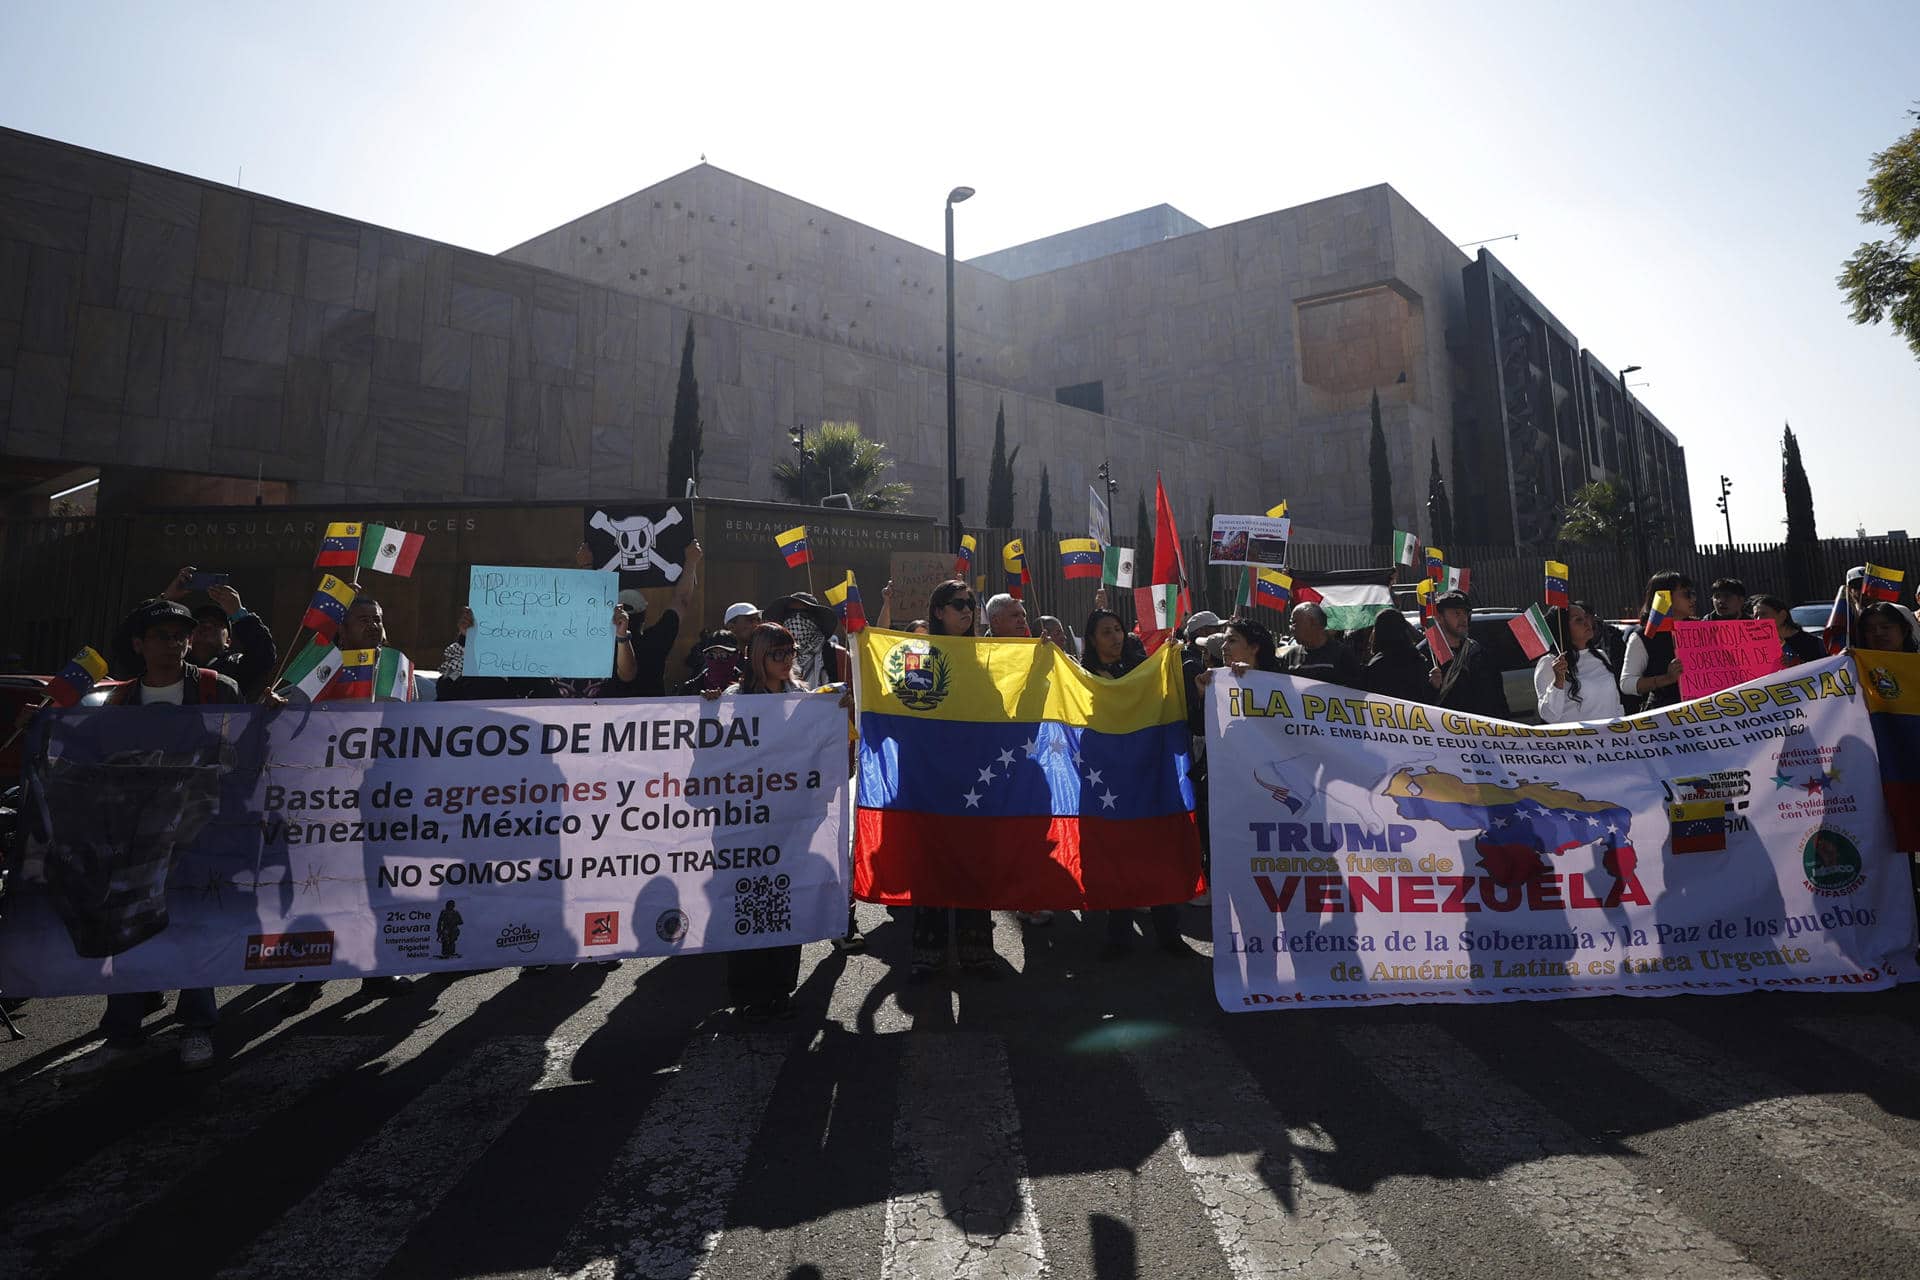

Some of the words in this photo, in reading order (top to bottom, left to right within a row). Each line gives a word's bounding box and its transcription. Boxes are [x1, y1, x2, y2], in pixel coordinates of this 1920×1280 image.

[164, 523, 316, 536] CONSULAR
[875, 530, 920, 542] CENTER
[1754, 646, 1773, 664] DE
[1301, 694, 1433, 733] PATRIA
[1667, 667, 1857, 726] RESPETA!
[324, 723, 531, 768] ¡GRINGOS
[540, 722, 592, 755] DE
[602, 716, 760, 753] MIERDA!
[1284, 723, 1325, 737] CITA:
[1331, 727, 1409, 746] EMBAJADA
[1413, 736, 1434, 747] DE
[1437, 737, 1477, 750] EEUU
[1481, 740, 1524, 751] CALZ.
[1528, 736, 1597, 751] LEGARIA
[1598, 737, 1607, 748] Y
[1611, 736, 1635, 748] AV.
[1639, 730, 1681, 745] CASA
[1685, 725, 1706, 739] DE
[1711, 720, 1731, 735] LA
[1733, 707, 1809, 731] MONEDA,
[1461, 753, 1495, 764] COL.
[1596, 745, 1673, 765] ALCALDIA
[1677, 736, 1741, 756] MIGUEL
[1744, 723, 1806, 745] HIDALGO
[264, 784, 360, 812] Basta
[371, 781, 413, 808] de
[424, 778, 607, 815] agresiones
[616, 779, 635, 807] y
[644, 768, 798, 800] chantajes
[806, 769, 821, 789] a
[262, 813, 449, 846] Venezuela,
[462, 809, 581, 840] México
[591, 812, 611, 841] y
[620, 800, 770, 832] Colombia
[1249, 822, 1417, 853] TRUMP
[377, 865, 422, 889] NO
[429, 860, 531, 887] SOMOS
[538, 858, 573, 882] SU
[581, 852, 661, 879] PATIO
[667, 844, 781, 874] TRASERO
[1251, 857, 1339, 873] manos
[1346, 852, 1413, 873] fuera
[1418, 853, 1454, 873] de
[1253, 872, 1652, 913] VENEZUELA
[383, 924, 431, 934] Guevara
[408, 910, 432, 920] Che
[1230, 931, 1263, 954] La
[1272, 928, 1377, 953] defensa
[1384, 928, 1417, 952] de
[1424, 930, 1449, 952] la
[1458, 926, 1596, 952] Soberanía
[1602, 930, 1616, 953] y
[1621, 925, 1648, 947] la
[1654, 922, 1701, 945] Paz
[1707, 919, 1738, 940] de
[1746, 916, 1779, 938] los
[1330, 962, 1364, 983] de
[1369, 958, 1484, 983] América
[1491, 957, 1580, 979] Latina
[1587, 959, 1616, 976] es
[1624, 954, 1692, 976] tarea
[1699, 943, 1812, 973] Urgente
